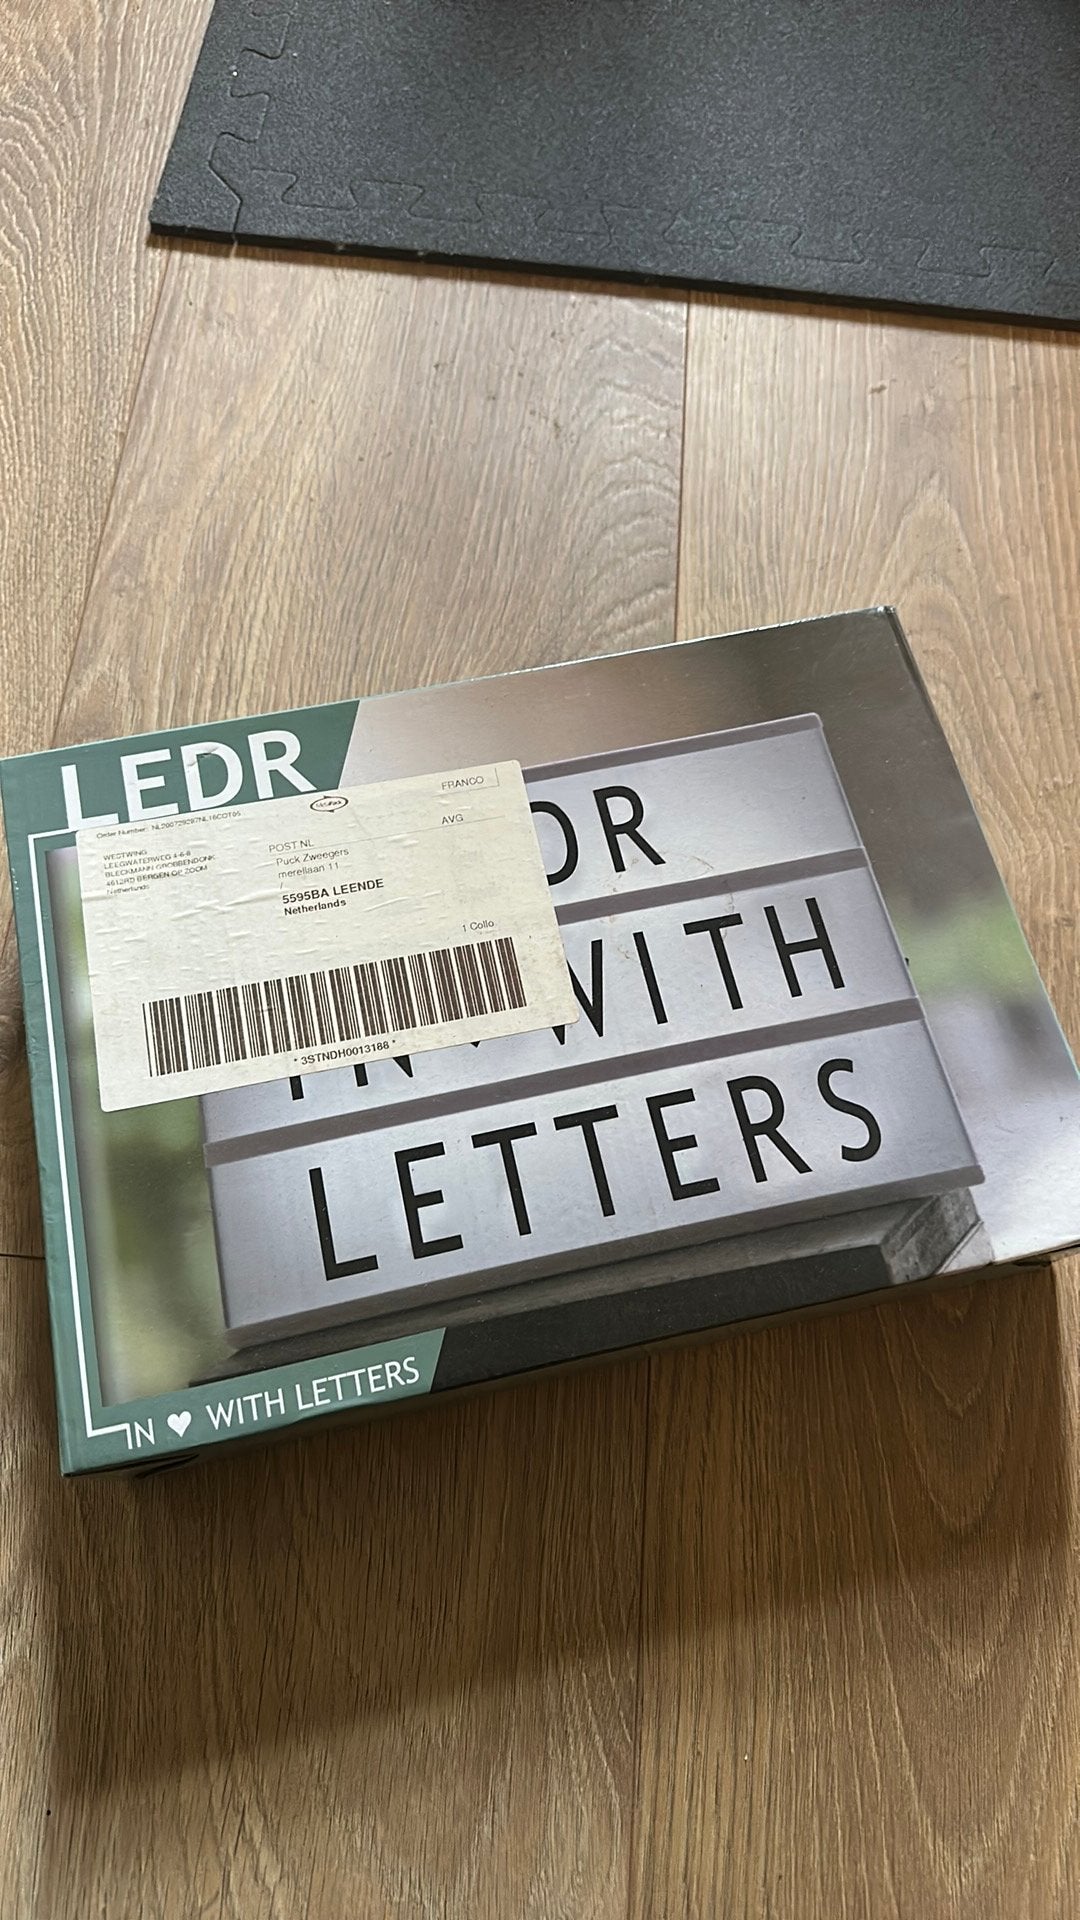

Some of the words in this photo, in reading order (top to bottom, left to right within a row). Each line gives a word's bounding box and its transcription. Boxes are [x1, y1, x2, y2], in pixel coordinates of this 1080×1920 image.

[61, 729, 318, 829] LEDR
[441, 775, 485, 790] FRANCO
[441, 813, 464, 825] AVG
[96, 831, 117, 839] Order
[268, 840, 298, 853] POST
[300, 838, 315, 848] NL
[103, 849, 148, 861] WESTWING
[276, 855, 301, 867] Puck
[302, 847, 350, 863] Zweegers
[136, 871, 170, 883] BERGEN
[184, 864, 208, 875] ZOOM
[278, 864, 325, 879] merellaan
[327, 861, 340, 871] 11
[282, 887, 330, 905] 5595BA
[332, 877, 385, 897] LEENDE
[284, 898, 347, 916] Netherlands
[469, 919, 495, 931] Collo
[308, 1057, 882, 1282] LETTERS
[127, 1417, 155, 1450] IN
[205, 1387, 286, 1431] WITH
[294, 1356, 421, 1412] LETTERS
